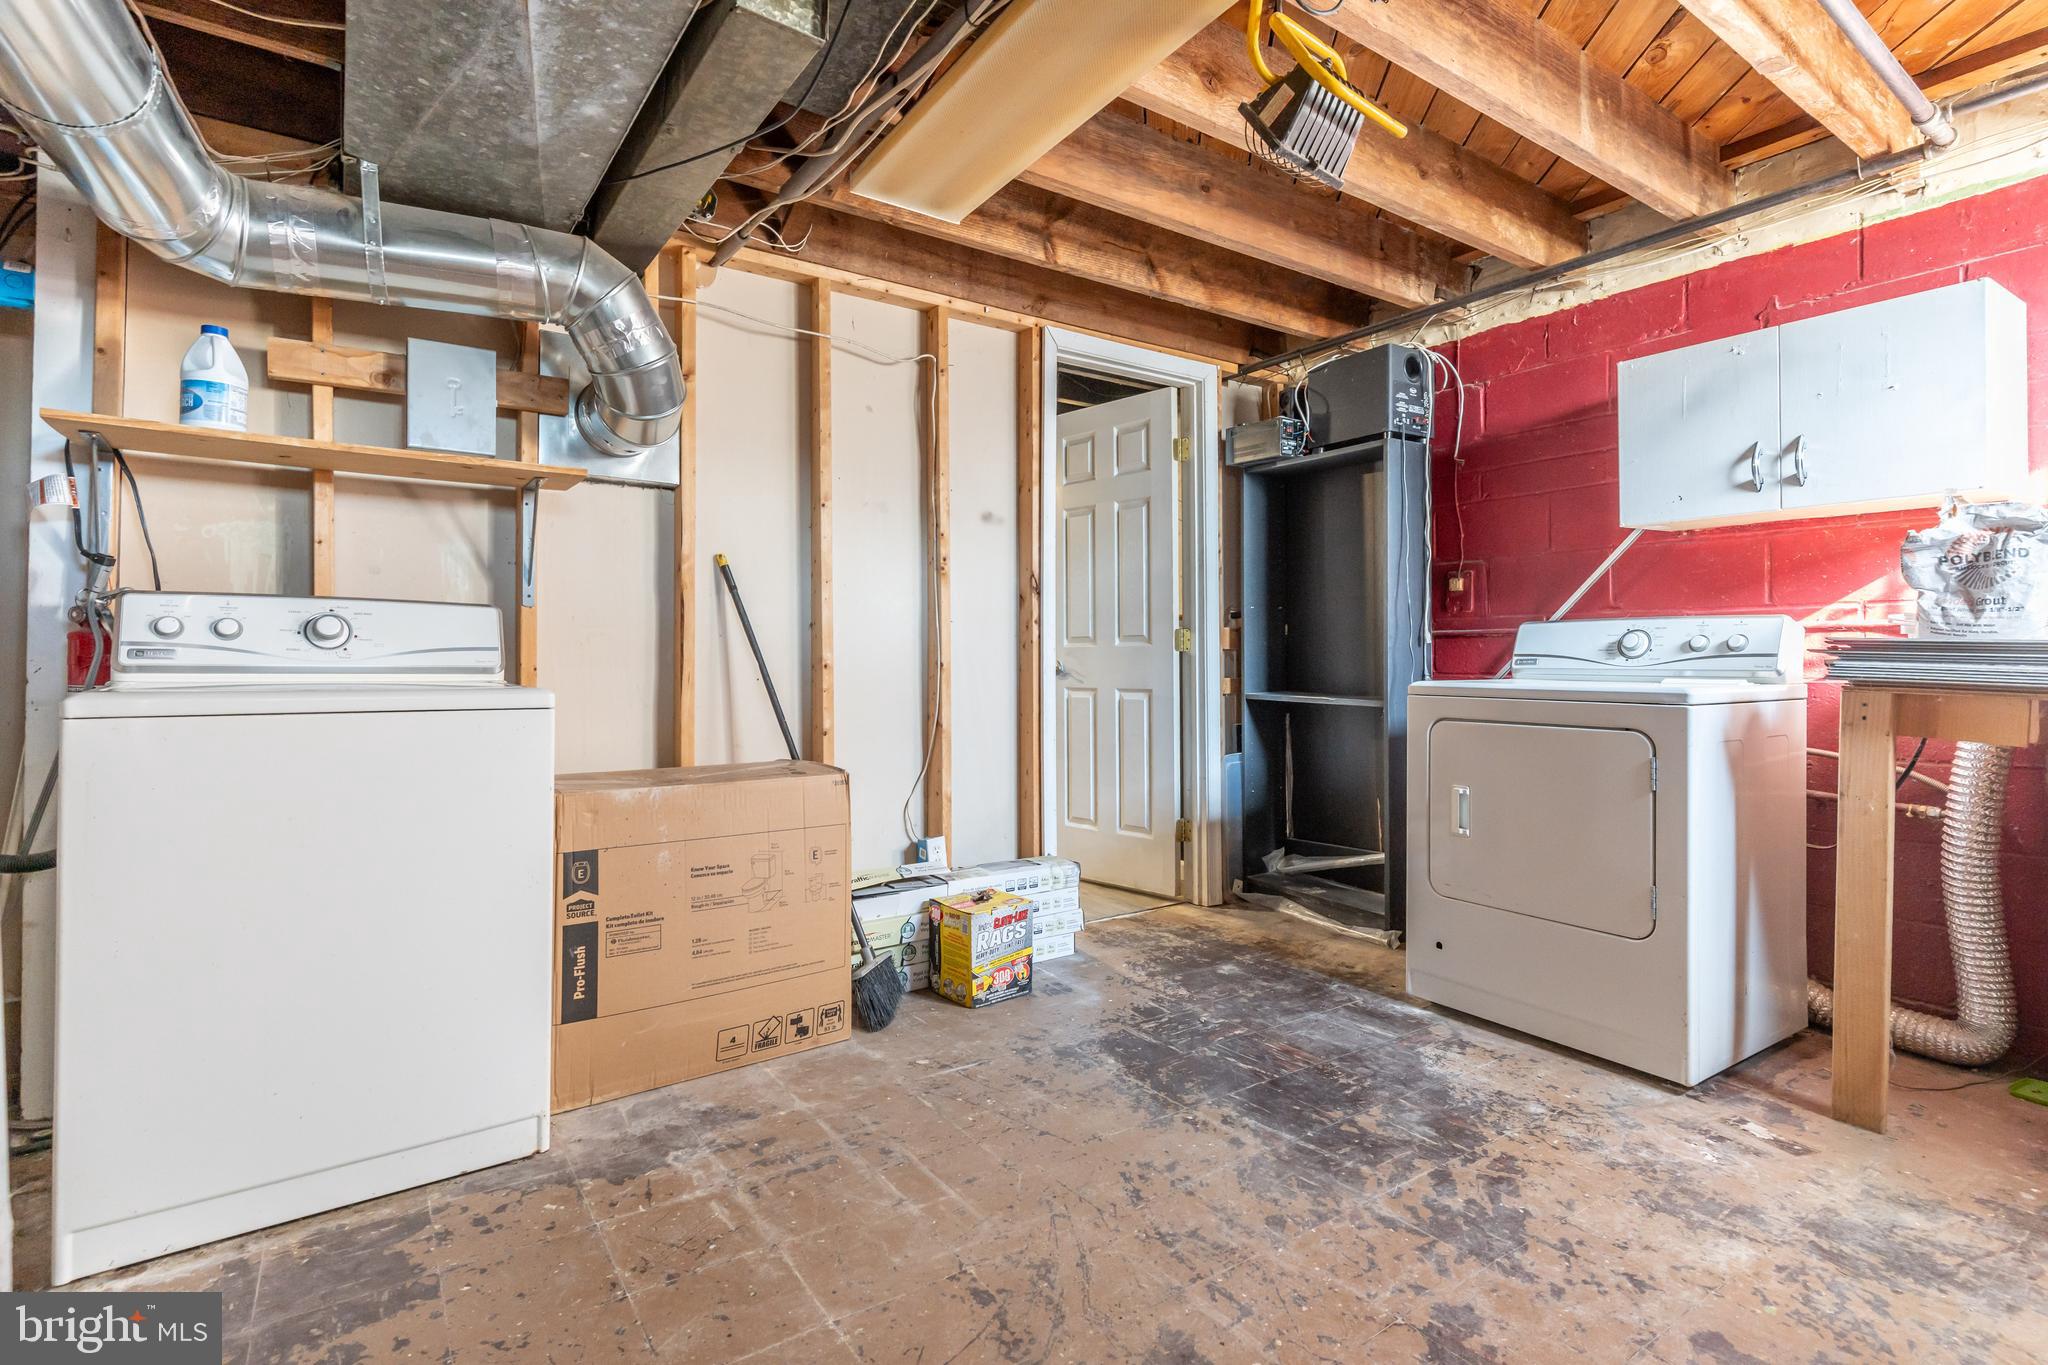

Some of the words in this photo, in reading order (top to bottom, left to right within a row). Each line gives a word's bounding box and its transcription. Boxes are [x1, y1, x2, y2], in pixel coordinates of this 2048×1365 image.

[812, 849, 819, 860] E
[577, 869, 585, 879] E
[568, 902, 593, 911] PROJECT
[566, 910, 595, 920] SOURCE
[976, 920, 1027, 953] RAGS
[573, 945, 587, 1000] Pro-Flush
[993, 968, 1011, 985] 300
[729, 1036, 736, 1044] 4
[754, 1038, 778, 1051] FRAGILE
